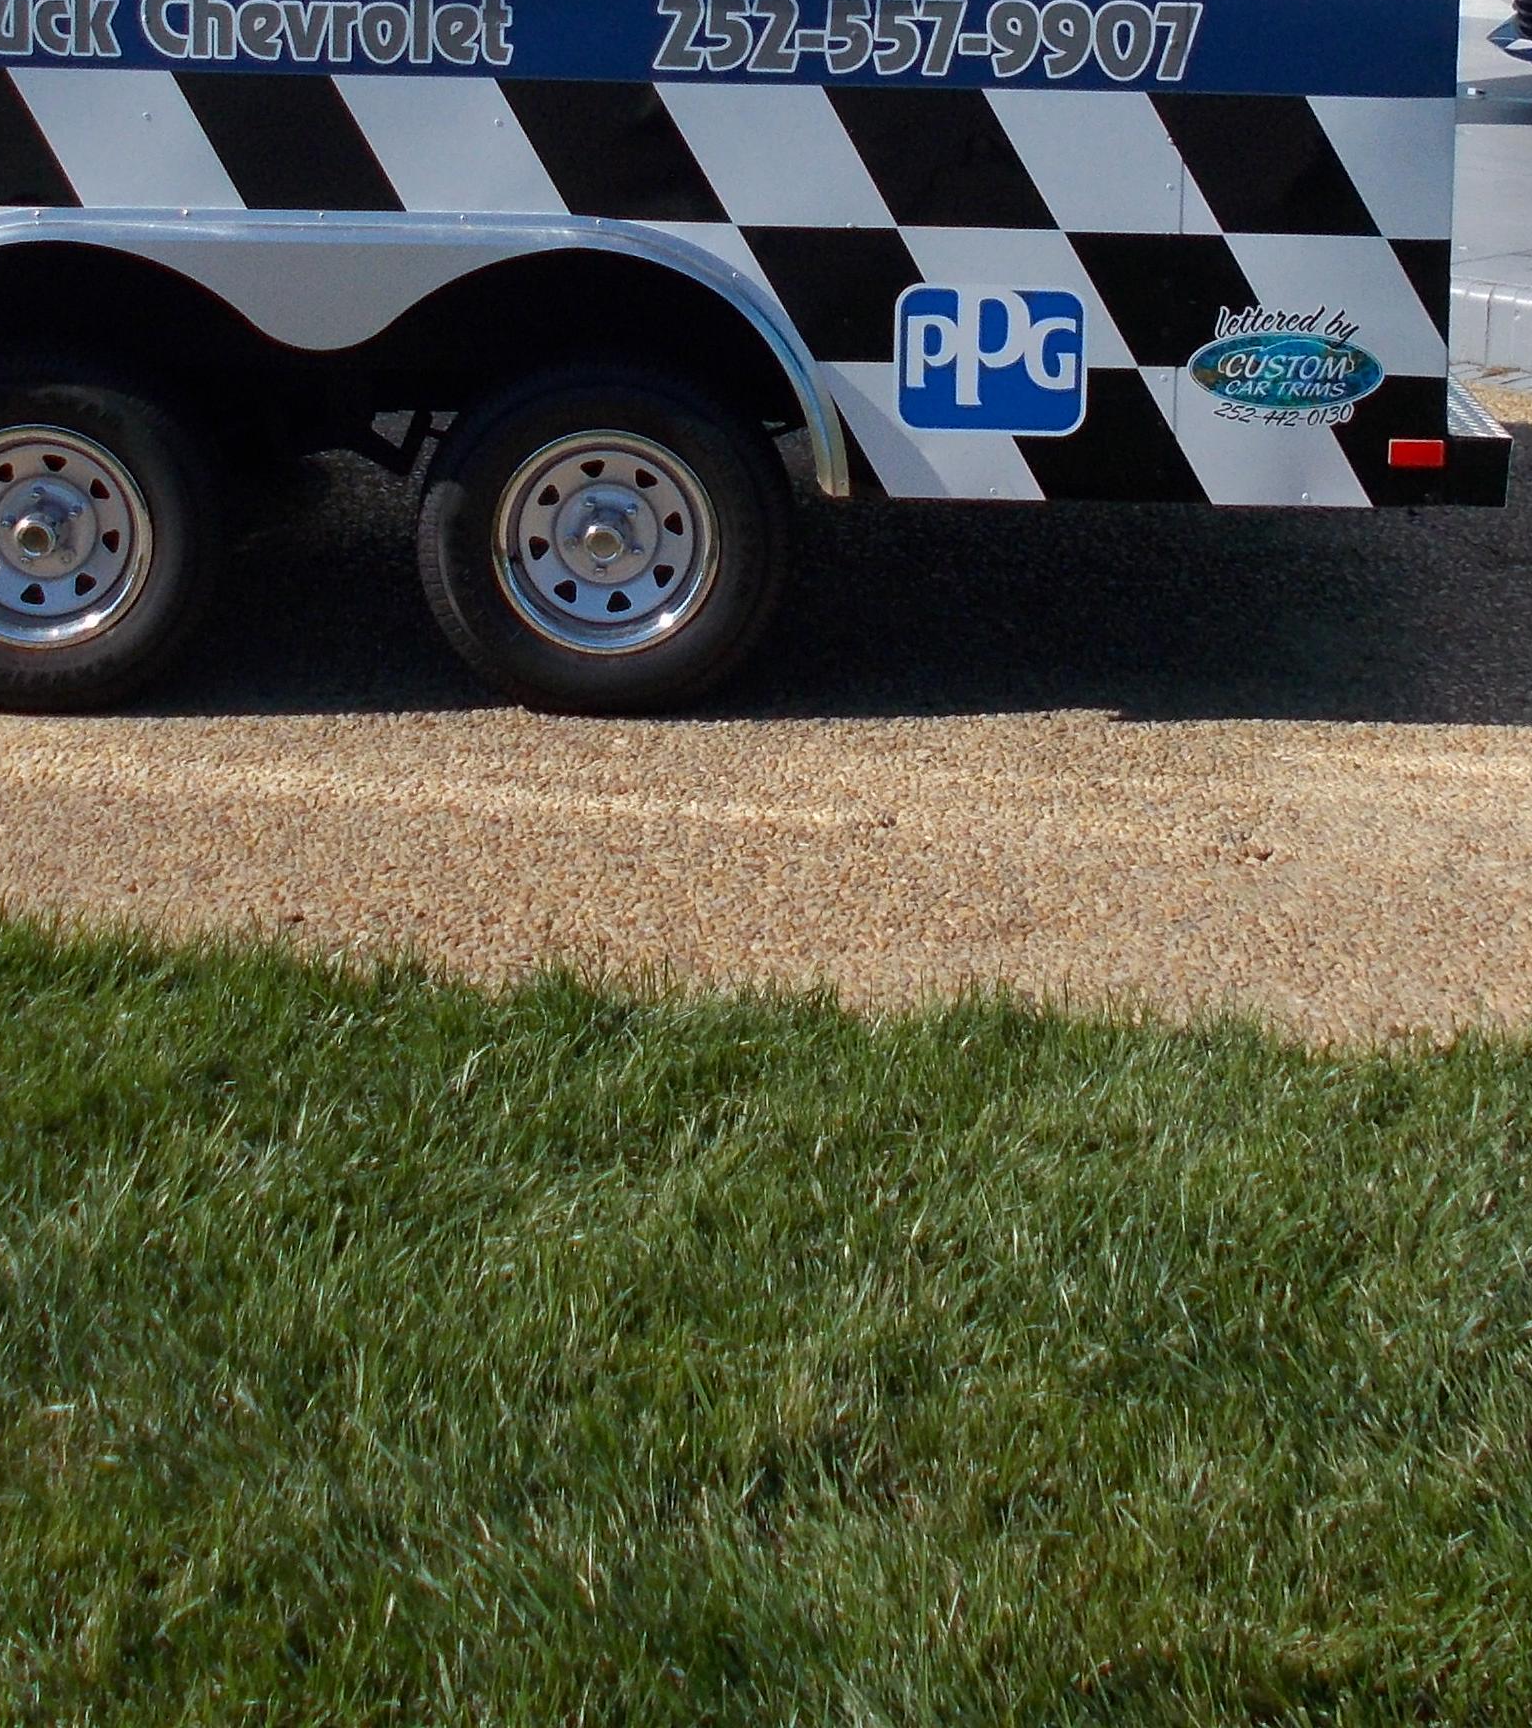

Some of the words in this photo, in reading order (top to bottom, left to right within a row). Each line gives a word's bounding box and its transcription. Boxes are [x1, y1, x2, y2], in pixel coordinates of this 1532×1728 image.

[1215, 305, 1325, 339] lettered
[1323, 309, 1360, 347] by
[1225, 353, 1348, 381] CUSTOM
[1225, 379, 1269, 397] CAR
[1278, 381, 1347, 398] TRIMS
[1213, 402, 1355, 427] 252-442-0130
